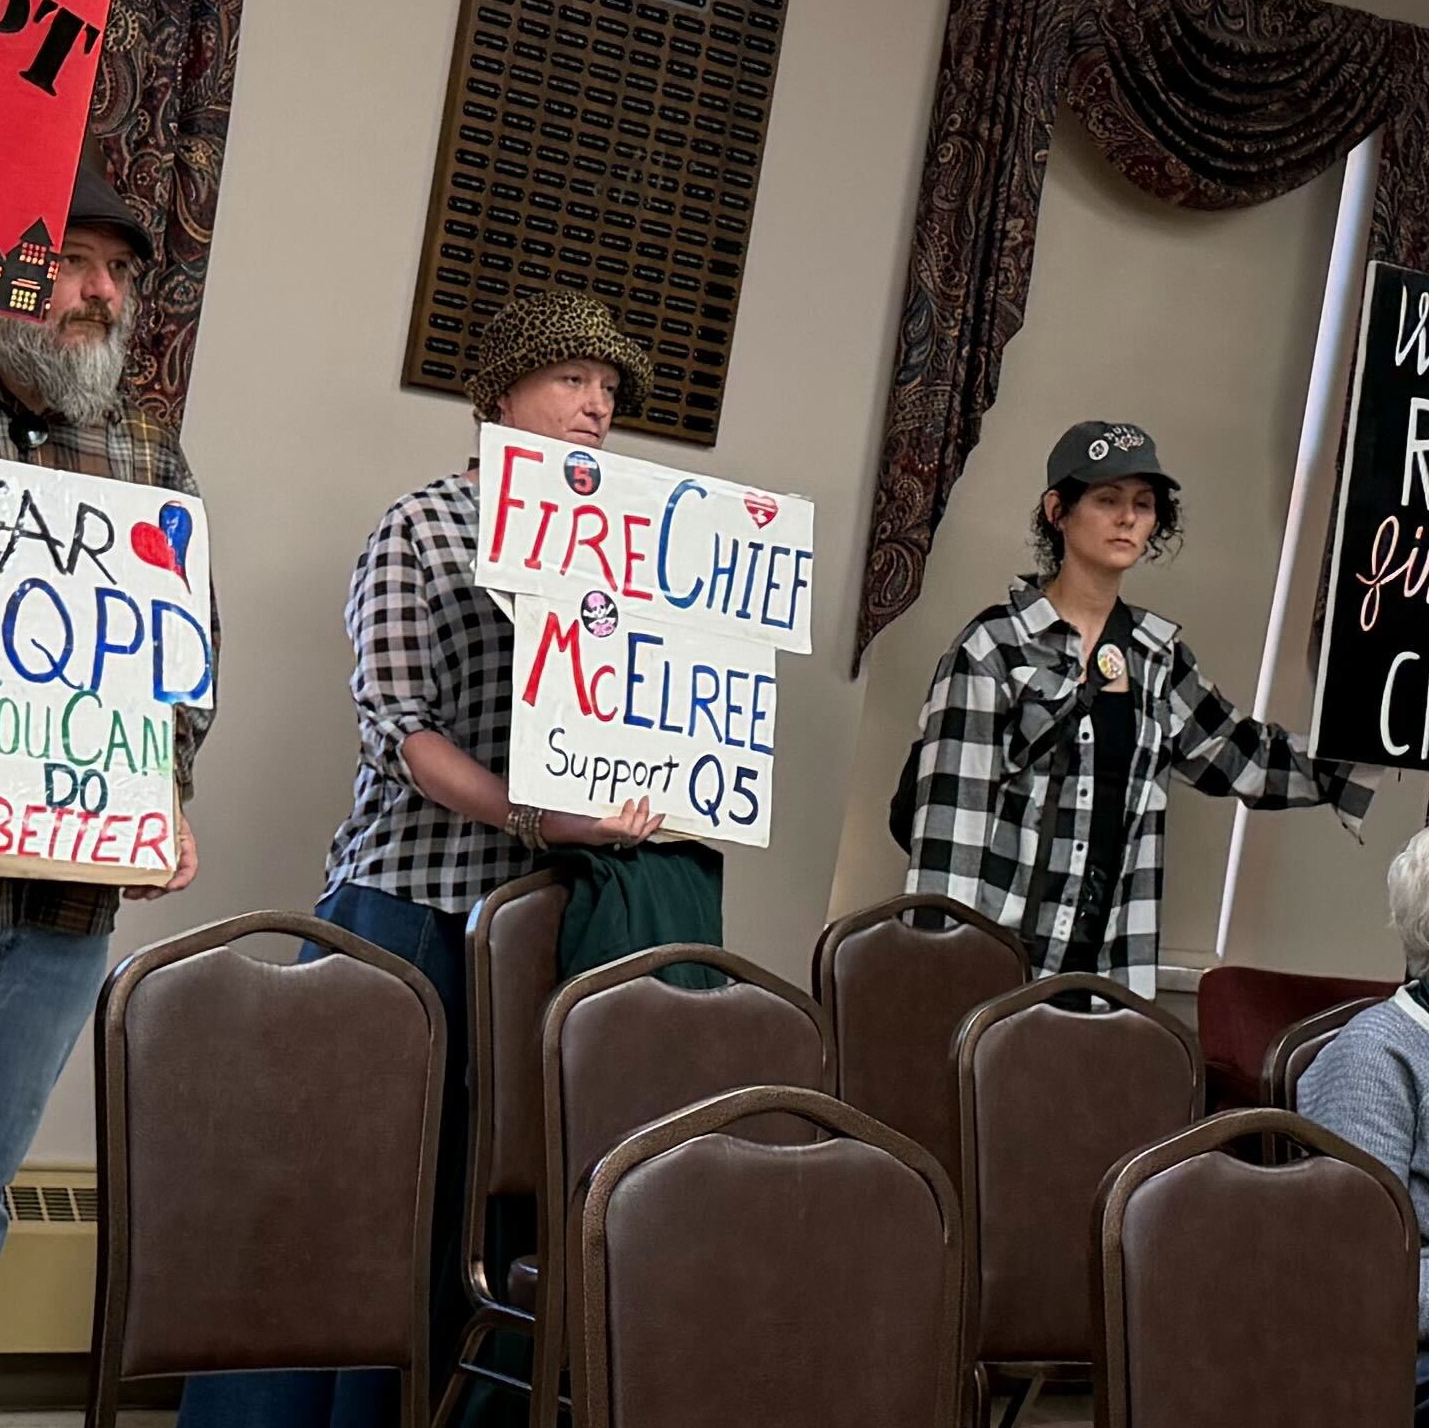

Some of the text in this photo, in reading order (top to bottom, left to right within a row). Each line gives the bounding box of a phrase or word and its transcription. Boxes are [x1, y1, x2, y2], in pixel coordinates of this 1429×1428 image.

[488, 445, 814, 631] FIRE CHIEF
[0, 576, 213, 705] QPD
[61, 688, 170, 777] CAN
[545, 727, 760, 827] Support Q5
[43, 761, 109, 814] DO
